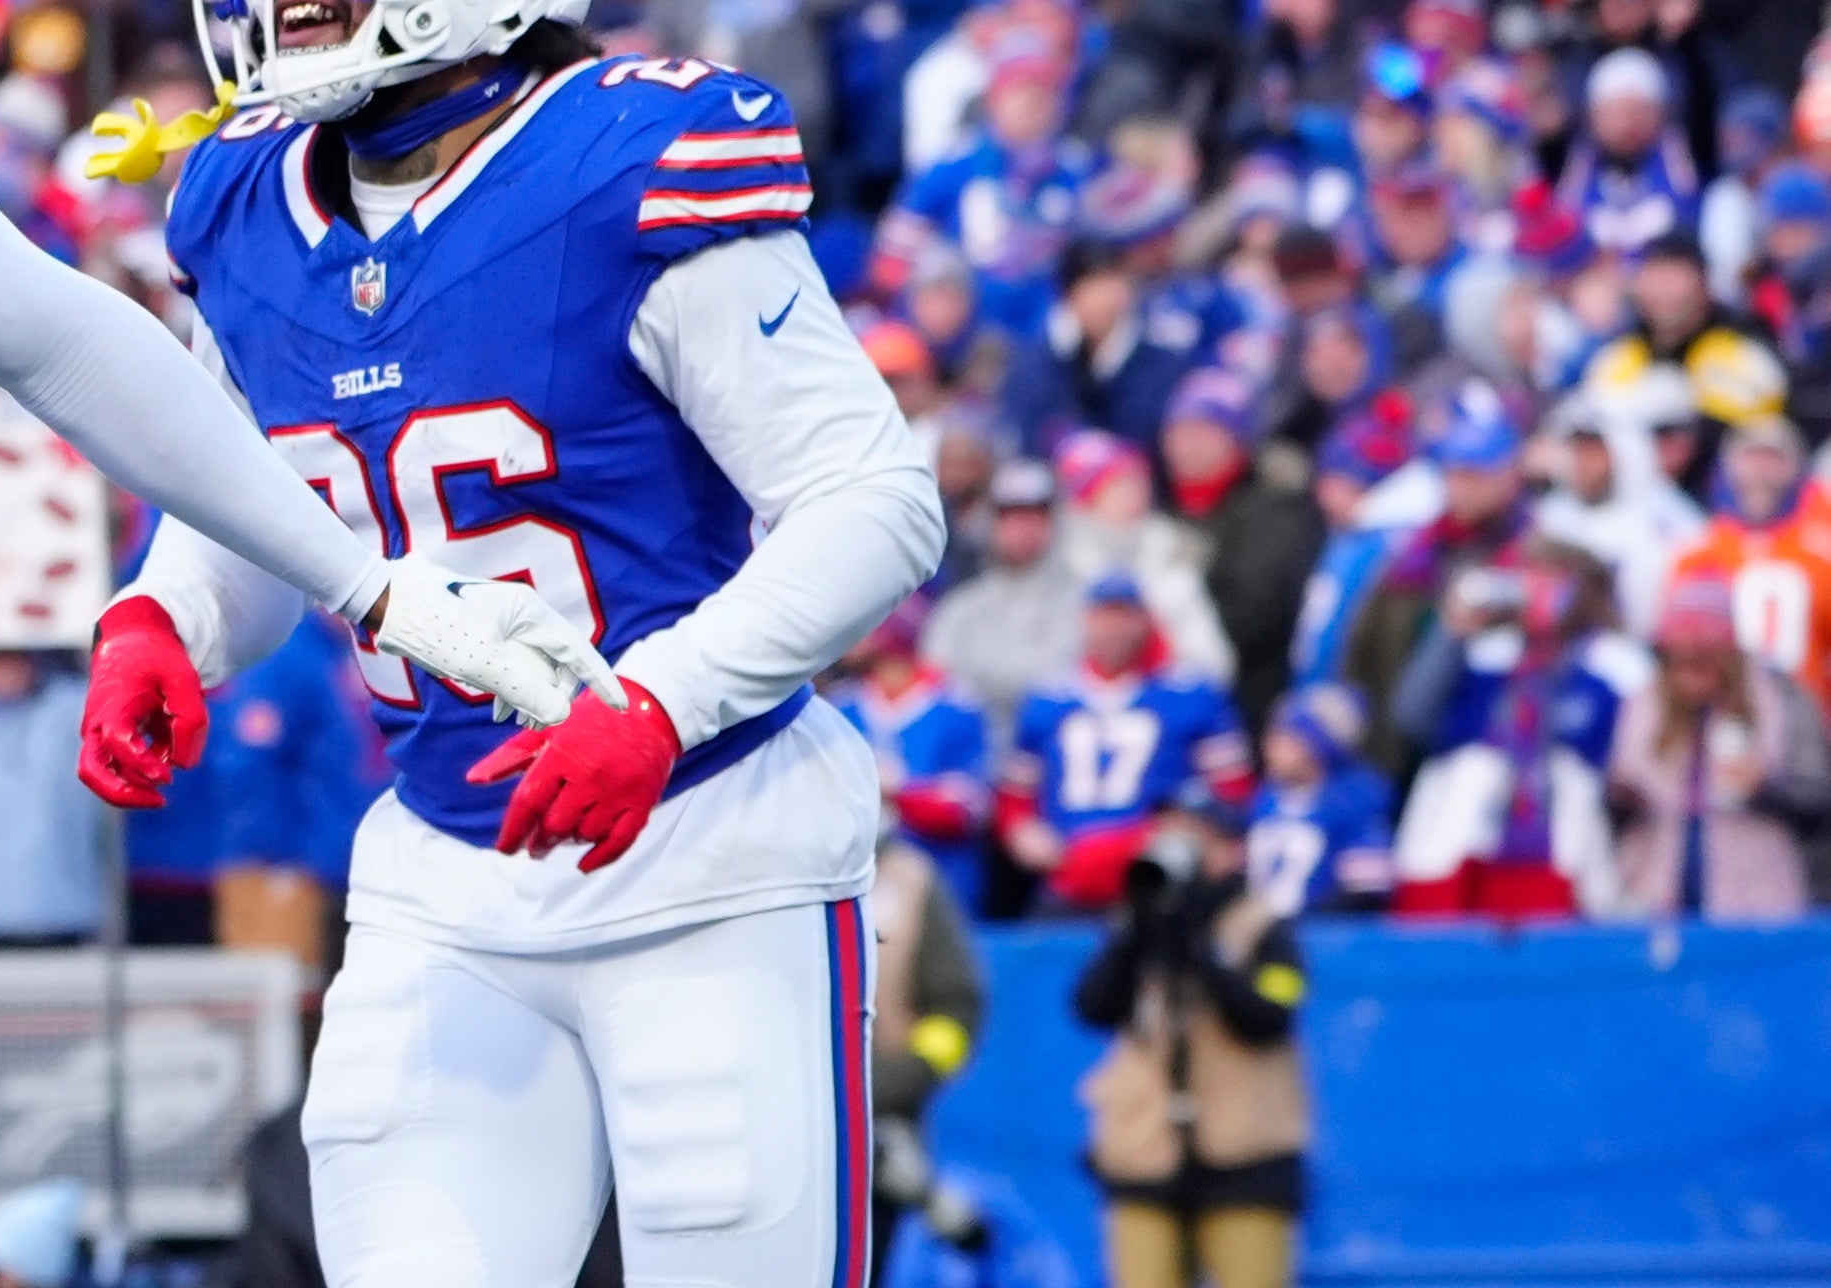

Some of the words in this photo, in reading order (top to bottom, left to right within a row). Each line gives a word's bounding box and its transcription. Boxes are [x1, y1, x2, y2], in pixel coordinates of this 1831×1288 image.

[358, 284, 380, 307] NFL
[331, 362, 403, 400] BILLS
[1059, 708, 1159, 810] 17
